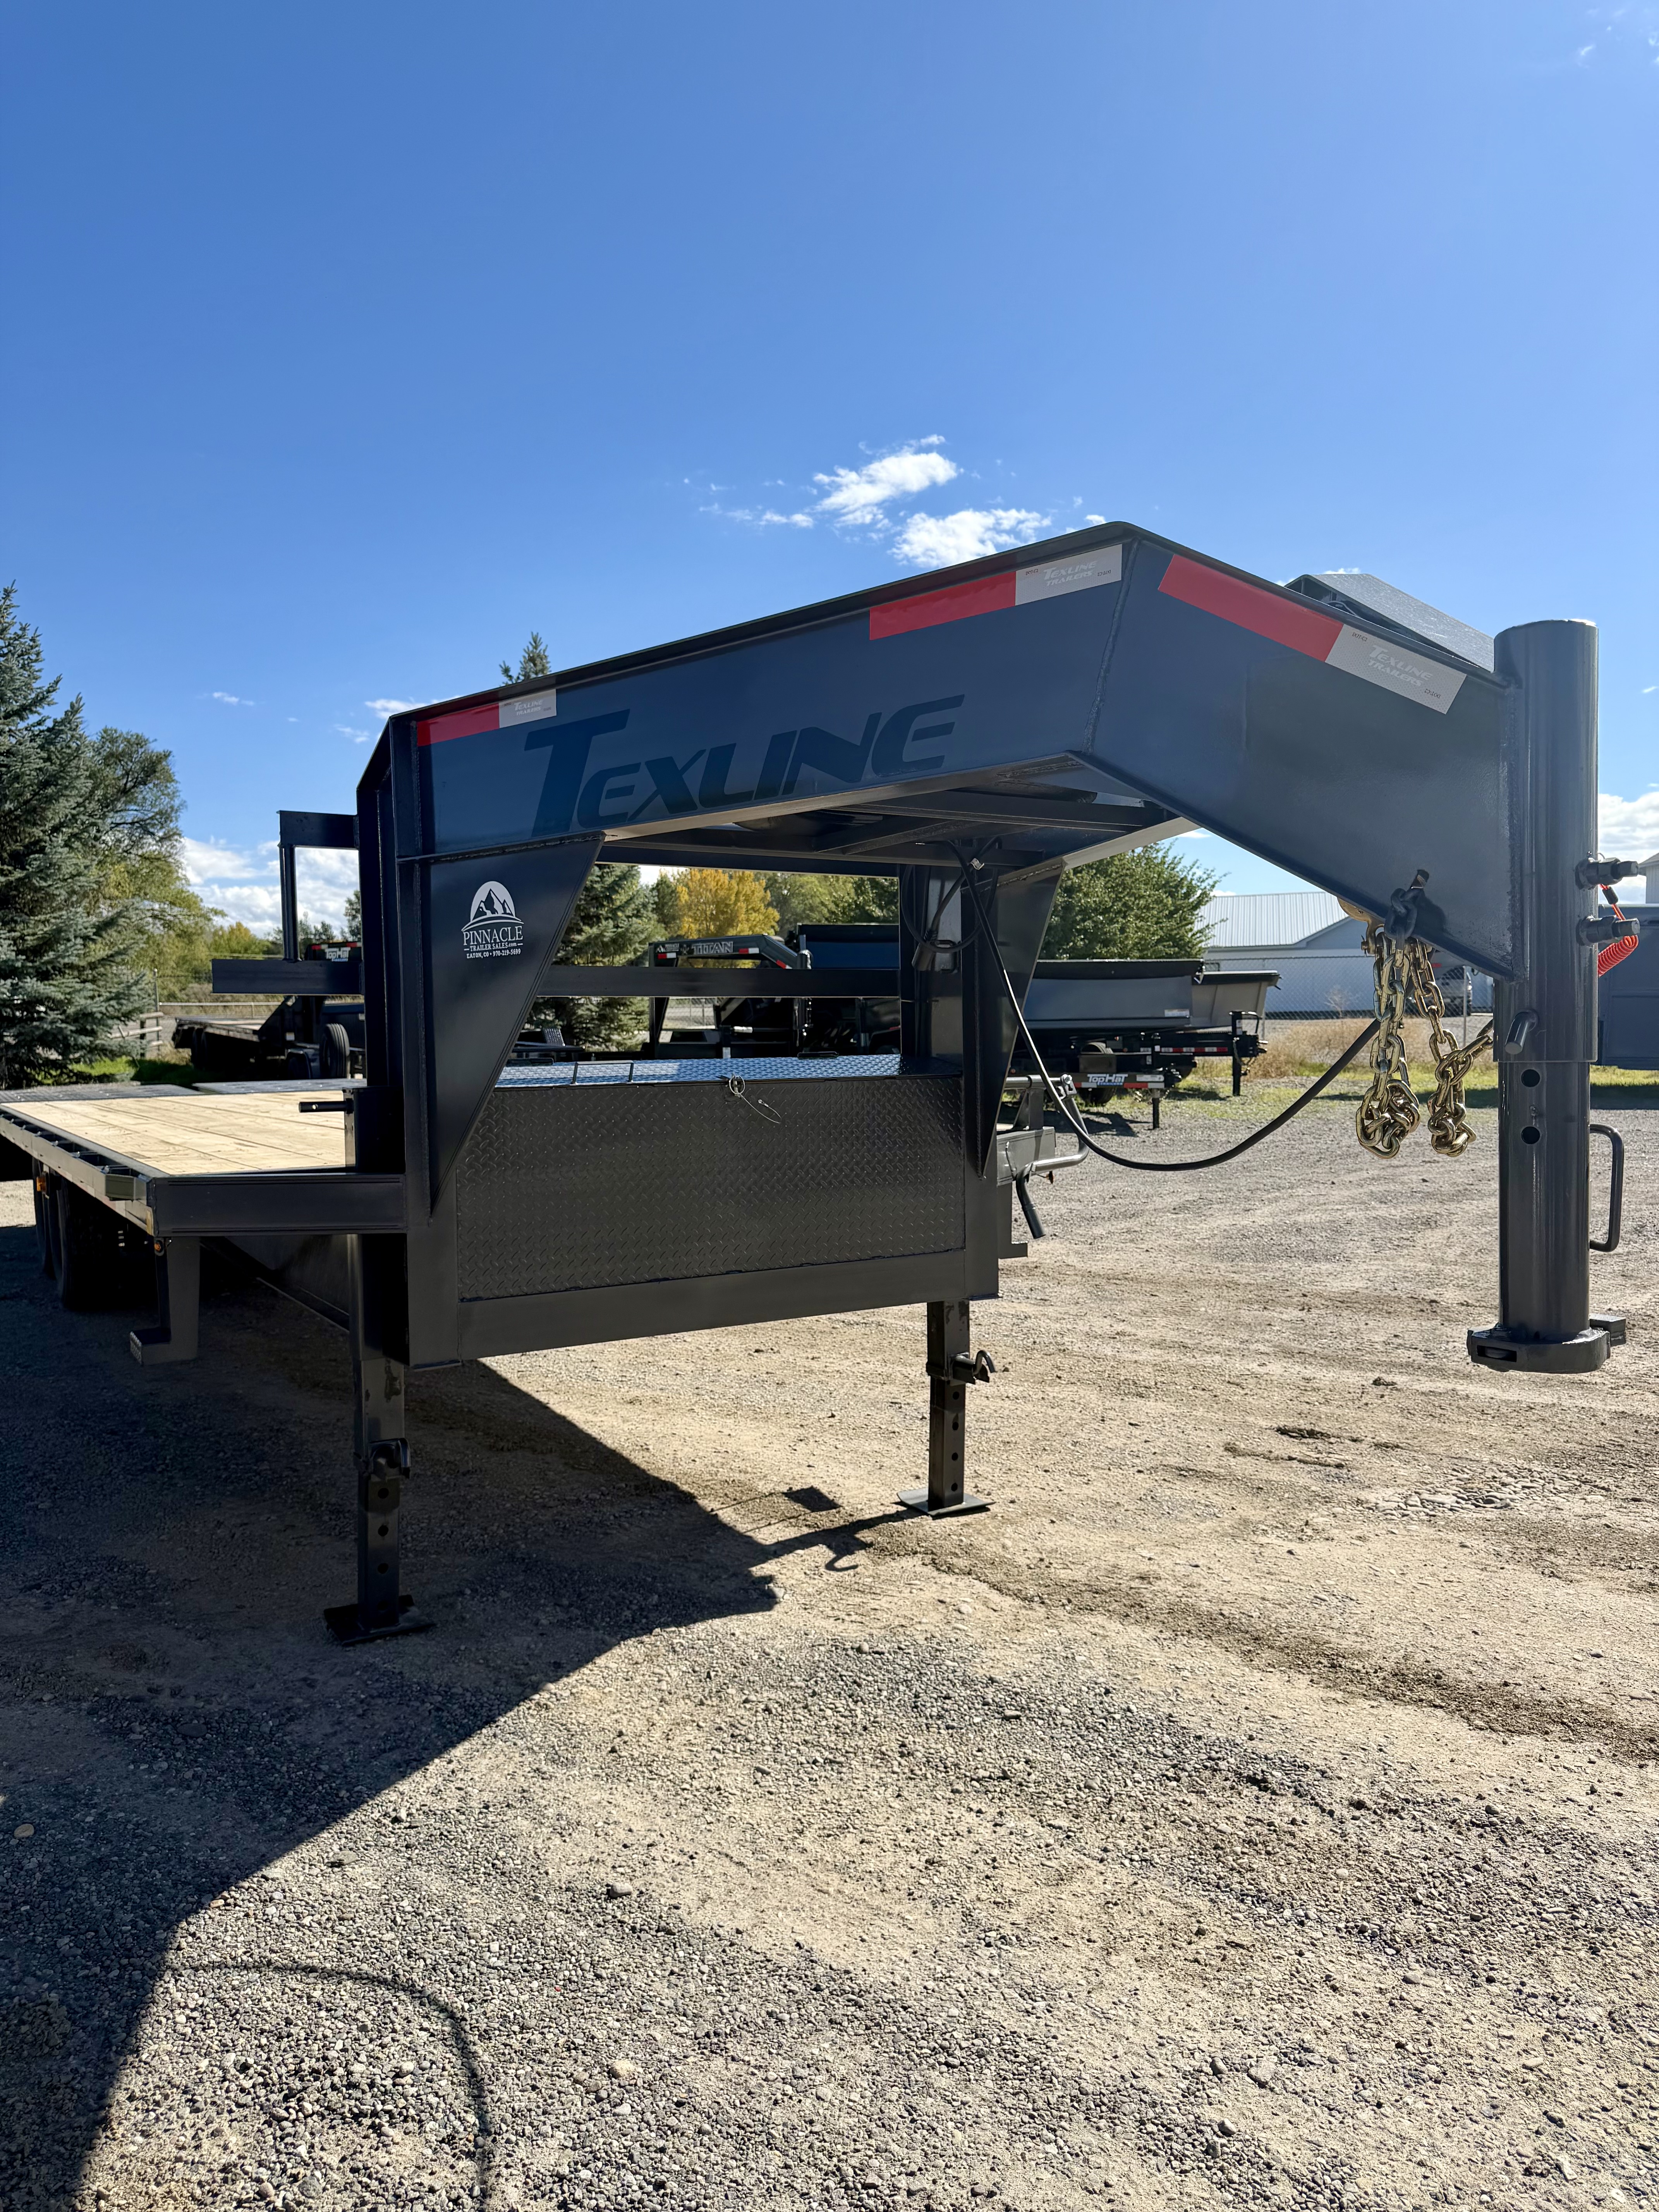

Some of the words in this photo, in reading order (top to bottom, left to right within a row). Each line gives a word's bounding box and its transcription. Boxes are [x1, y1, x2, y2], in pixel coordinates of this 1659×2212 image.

[1044, 561, 1097, 580] TEXLINE
[1352, 632, 1368, 642] DOT-C2
[1369, 644, 1433, 681] TEXLINE
[1369, 659, 1422, 687] TRAILERS
[524, 694, 965, 838] TEXLINE
[463, 926, 523, 946] PINNACLE
[493, 948, 521, 957] 970-219-5699
[692, 941, 733, 955] TITAN
